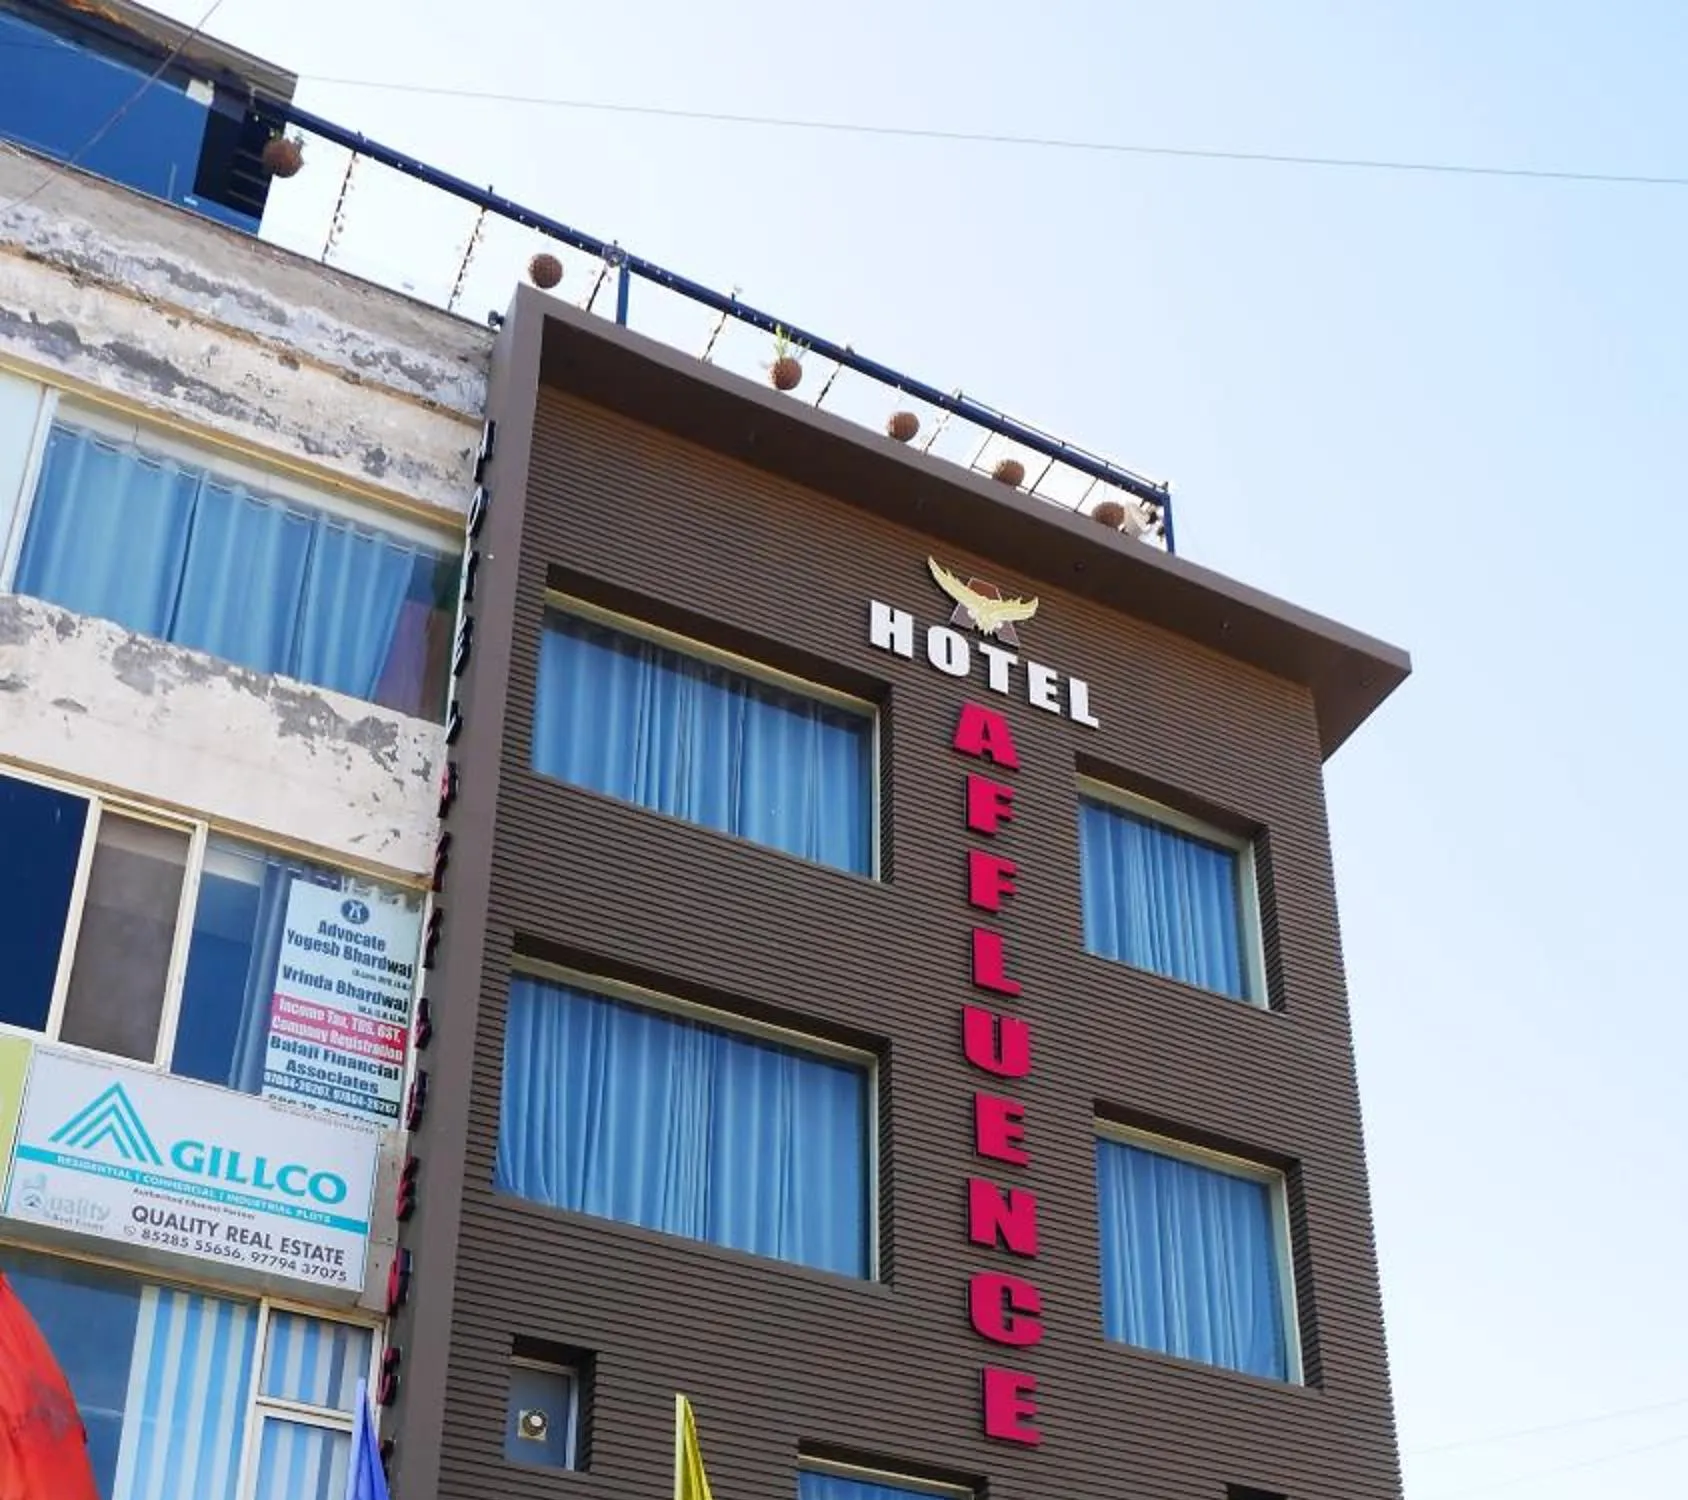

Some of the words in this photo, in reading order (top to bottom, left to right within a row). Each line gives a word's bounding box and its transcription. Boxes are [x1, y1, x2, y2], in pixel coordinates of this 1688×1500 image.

[870, 600, 1099, 728] HOTEL
[287, 928, 340, 957] Yogesh
[343, 944, 412, 979] Bhardwaj
[318, 920, 386, 952] Advocate
[279, 997, 325, 1021] Income
[283, 965, 333, 991] Vrinda
[336, 979, 408, 1013] Bhardwaj
[270, 1035, 320, 1059] Balaji
[323, 1049, 399, 1081] Financial
[272, 1015, 329, 1043] Company
[329, 1029, 403, 1060] Registration
[286, 1059, 379, 1094] Associates
[953, 702, 1045, 1446] AFFLUENCE
[57, 1155, 134, 1180] RESIDENTIAL
[143, 1175, 215, 1198] COMMERCIAL
[226, 1193, 294, 1215] INDUSTRIAL
[295, 1208, 332, 1224] PLOTS
[171, 1140, 348, 1205] GILLCO
[131, 1205, 220, 1237] QUALITY
[226, 1226, 273, 1250] REAL
[280, 1237, 345, 1266] ESTATE
[141, 1228, 189, 1249] 85285
[251, 1251, 297, 1271] 97794
[301, 1263, 347, 1283] 37075
